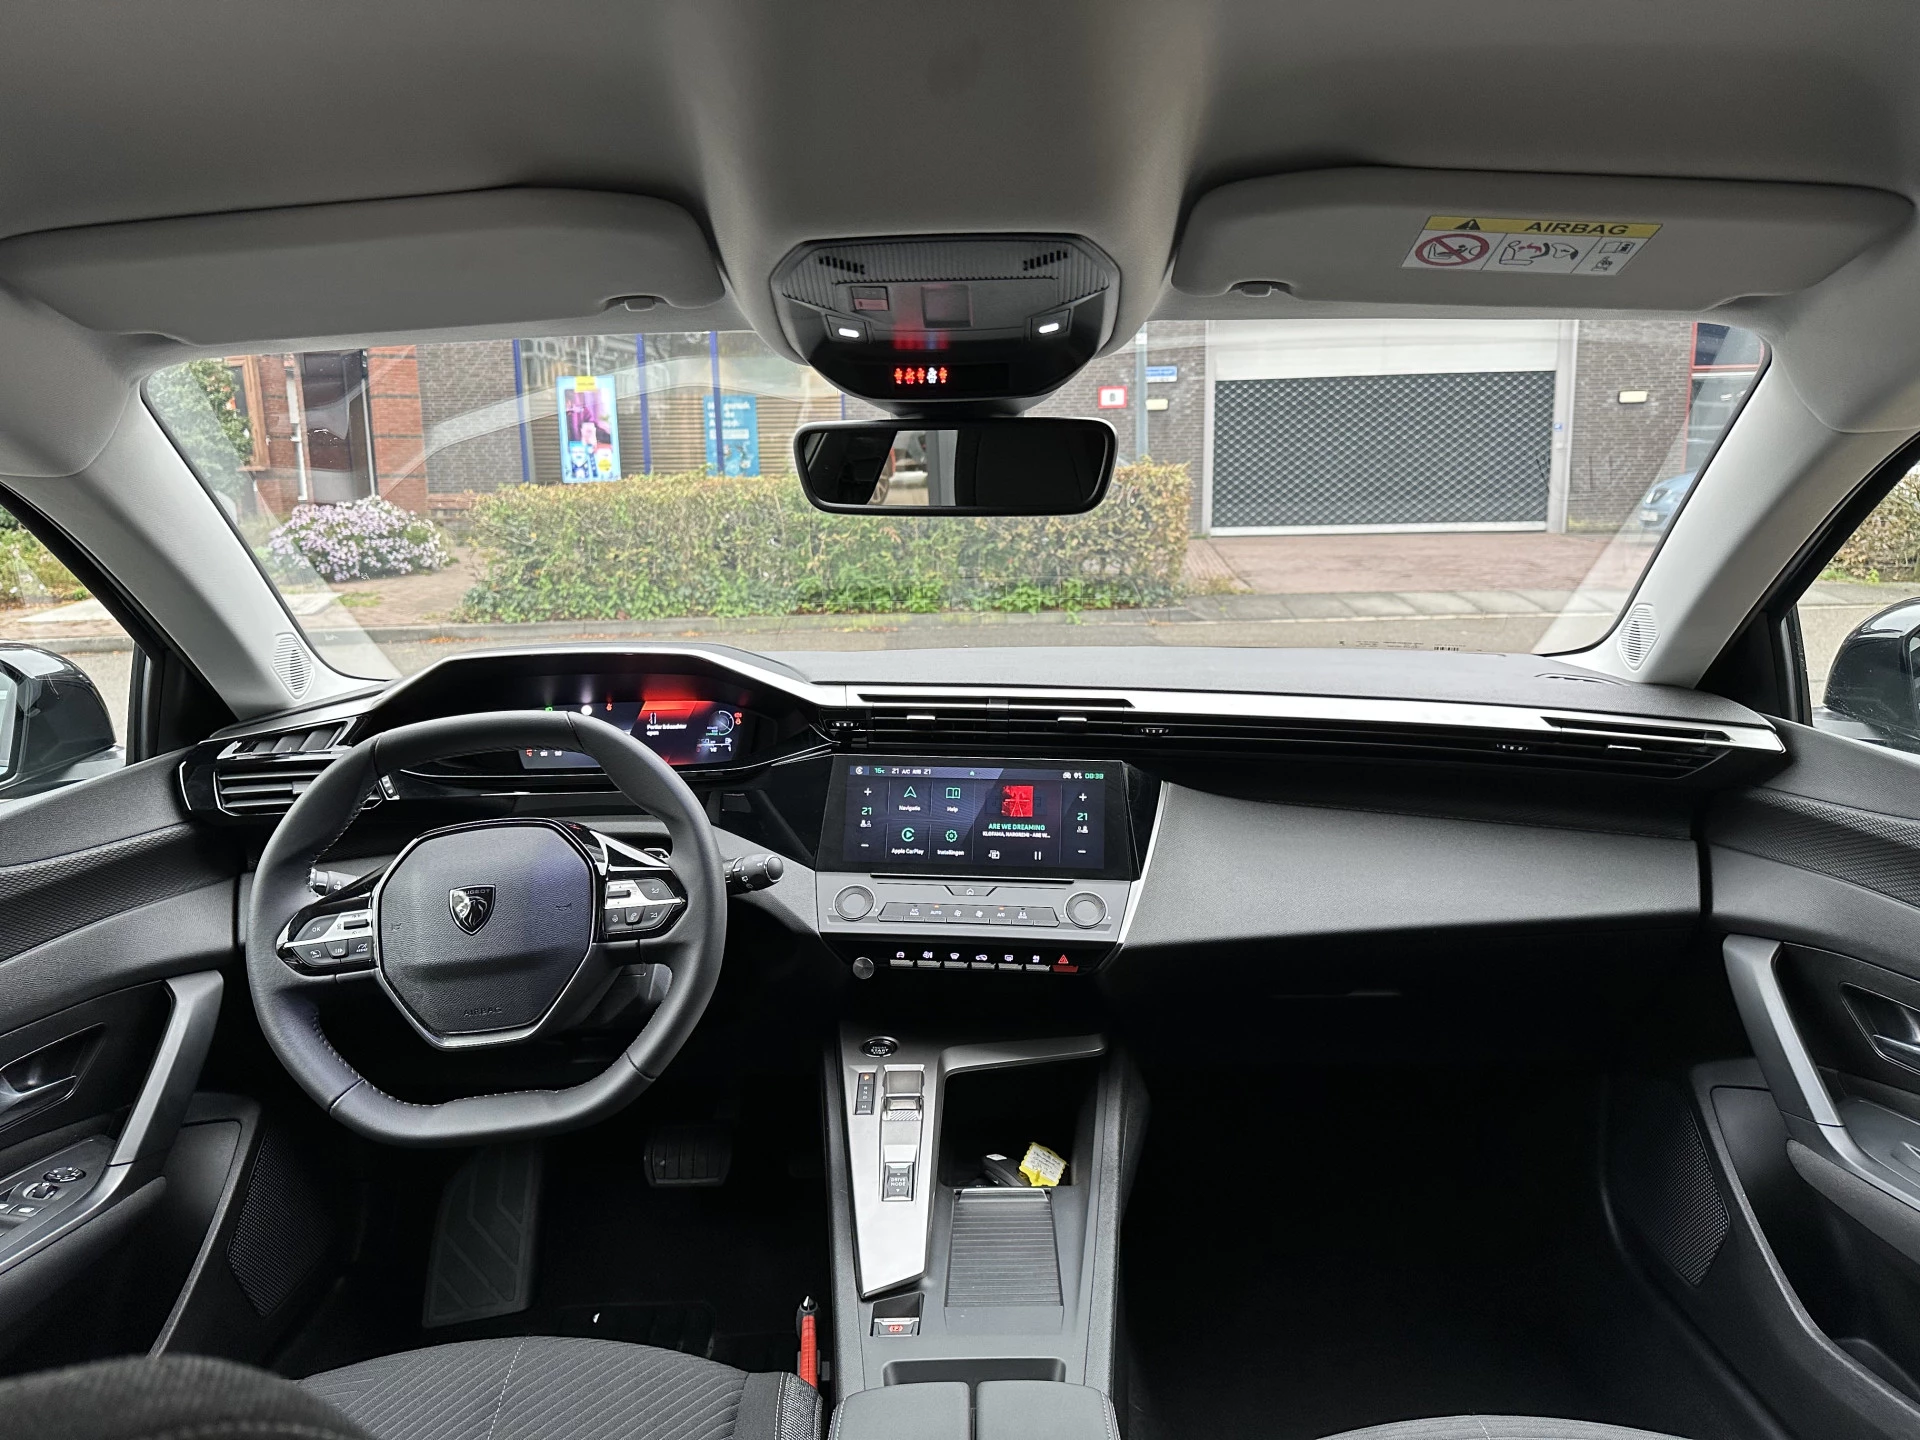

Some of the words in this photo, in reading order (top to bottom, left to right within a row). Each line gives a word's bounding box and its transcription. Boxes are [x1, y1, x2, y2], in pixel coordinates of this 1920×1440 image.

[1524, 222, 1629, 235] AIRBAG
[861, 806, 872, 815] 21
[1077, 812, 1088, 821] 21
[1001, 823, 1012, 831] WE
[891, 847, 905, 855] Apple
[905, 848, 925, 856] CarPlay
